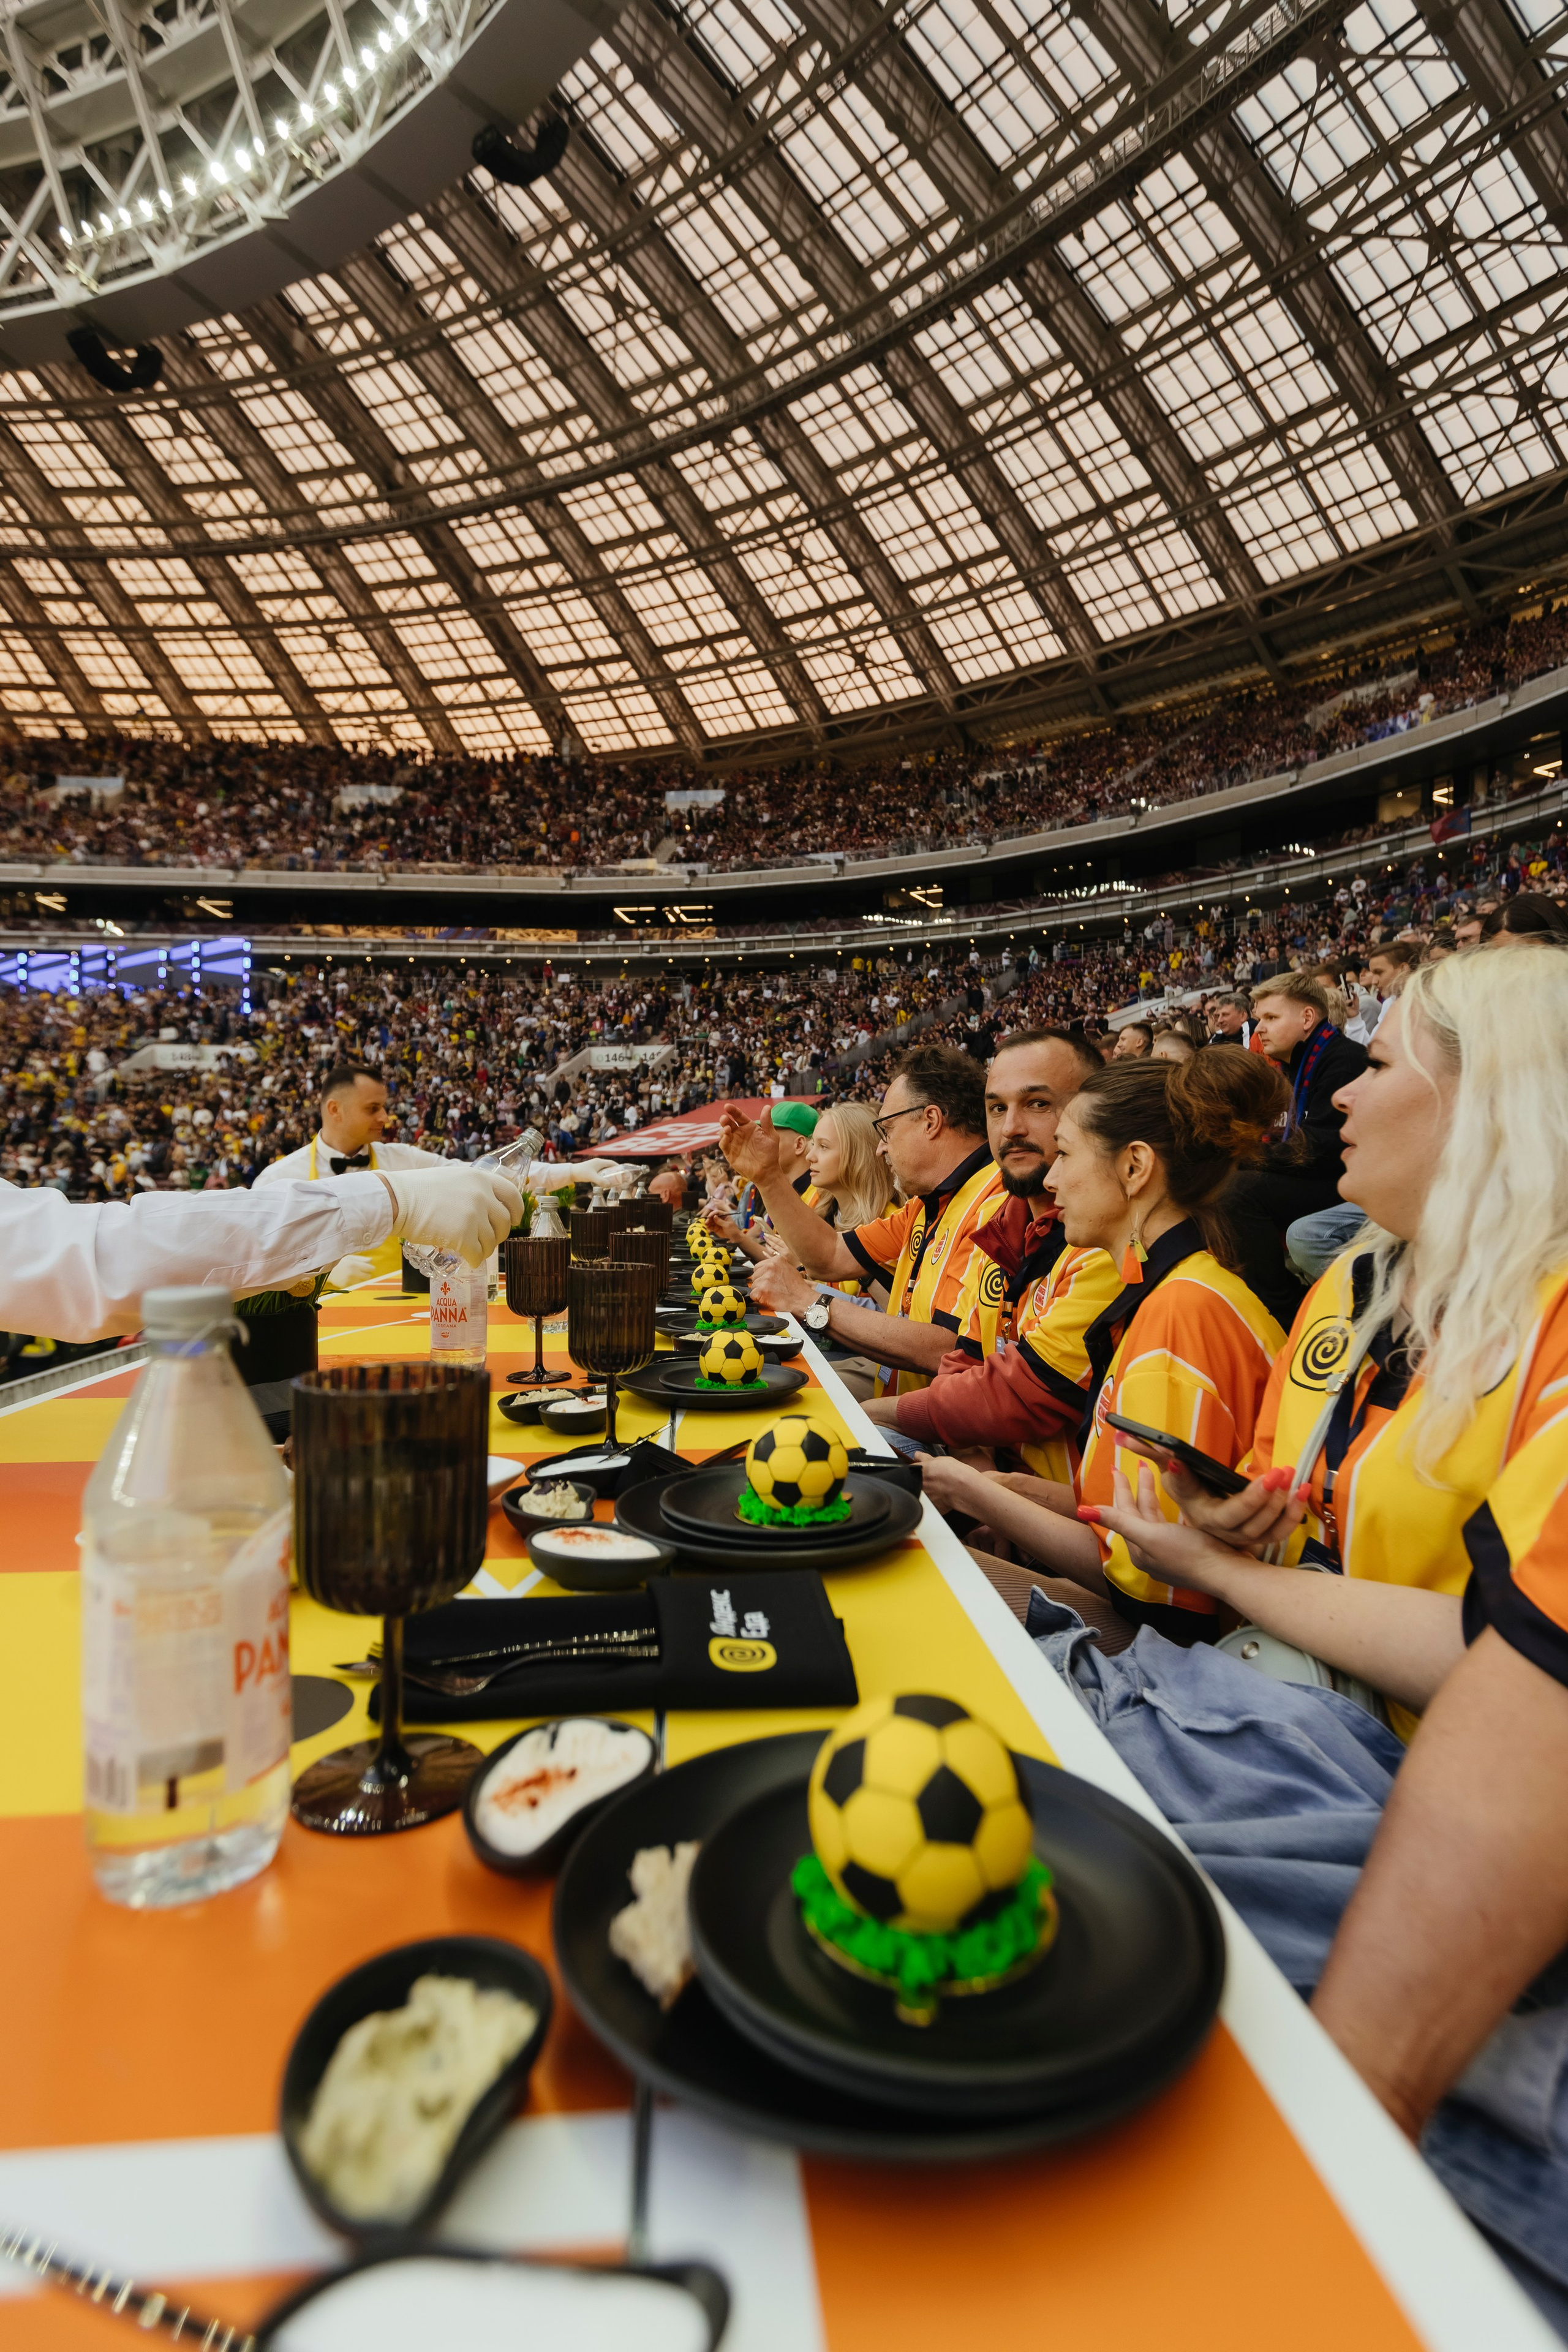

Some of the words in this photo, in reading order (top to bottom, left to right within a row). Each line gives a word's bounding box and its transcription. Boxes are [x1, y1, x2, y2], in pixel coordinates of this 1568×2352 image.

[605, 1053, 625, 1062] 146
[593, 1136, 720, 1152] BET
[436, 1297, 457, 1306] ACQUA
